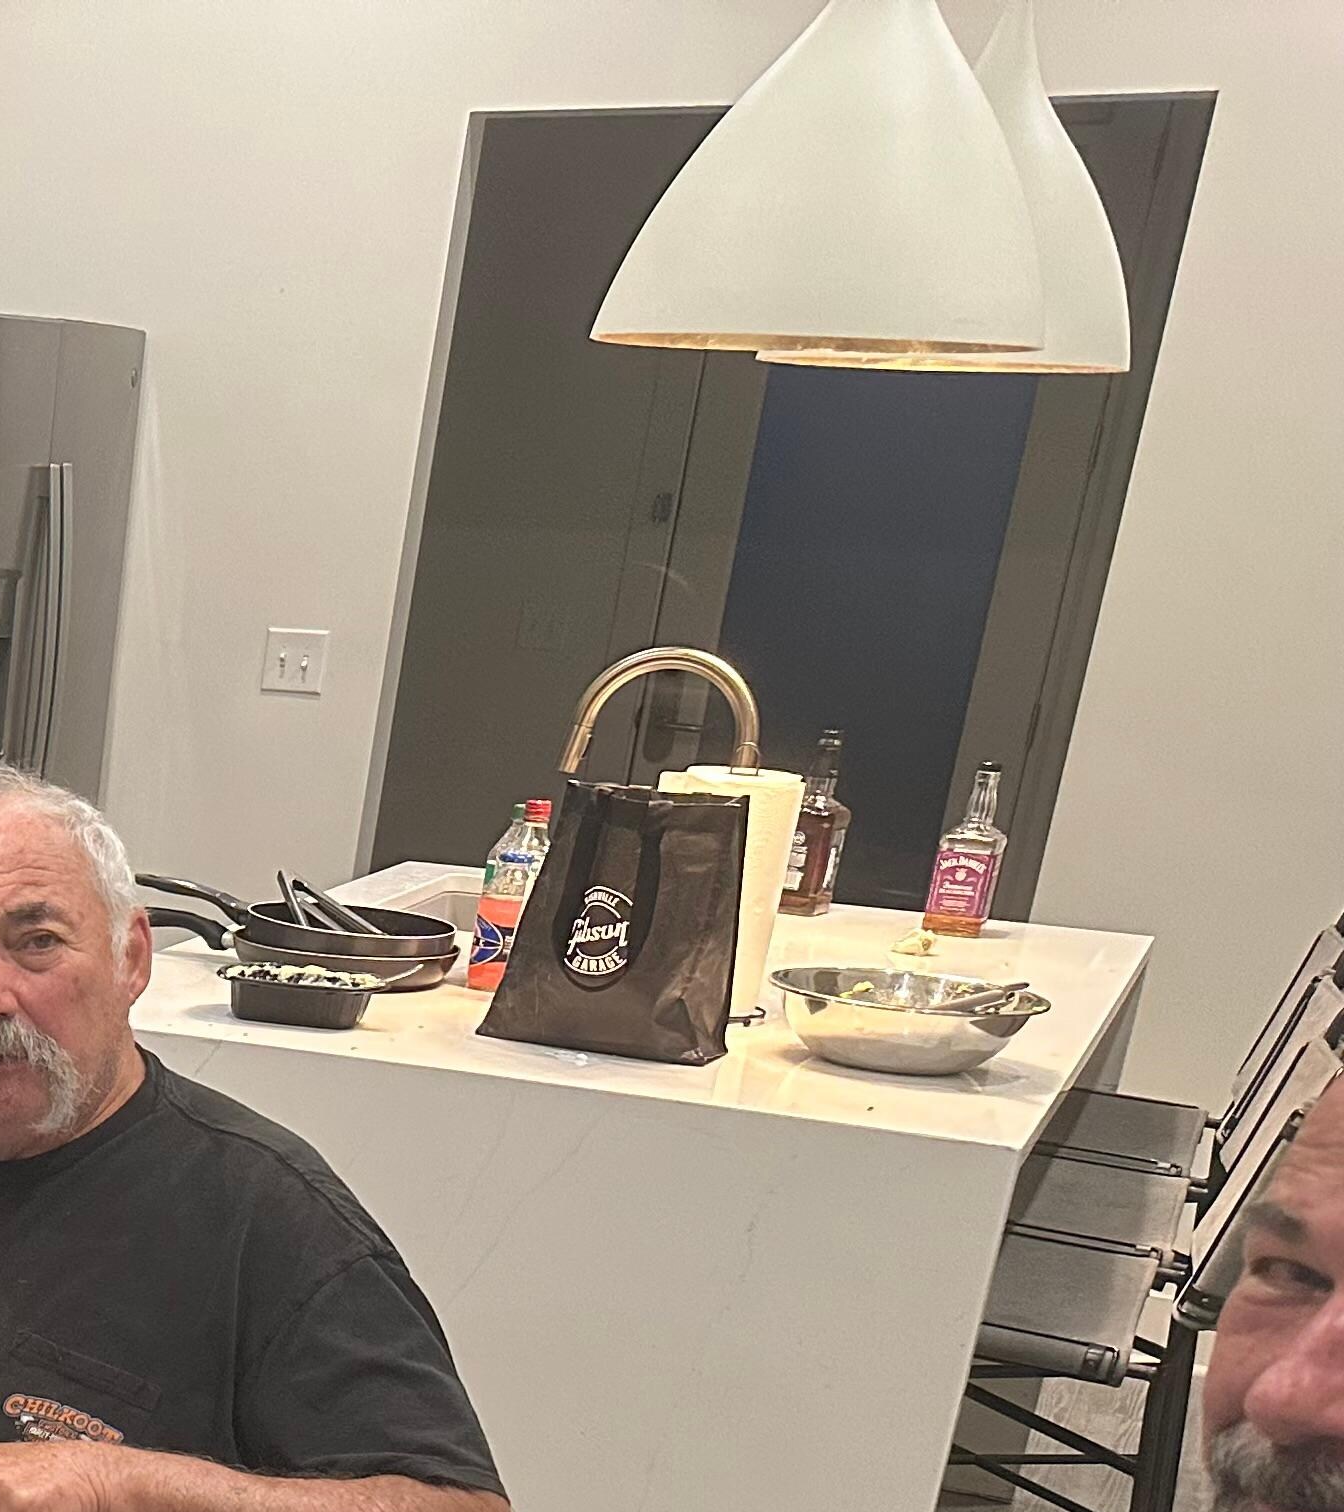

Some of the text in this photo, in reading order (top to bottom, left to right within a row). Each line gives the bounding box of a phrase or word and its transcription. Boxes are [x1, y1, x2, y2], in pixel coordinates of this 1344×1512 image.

[566, 916, 631, 956] Gibson
[571, 951, 624, 973] GARAGE
[3, 1394, 125, 1443] CHILKOOT
